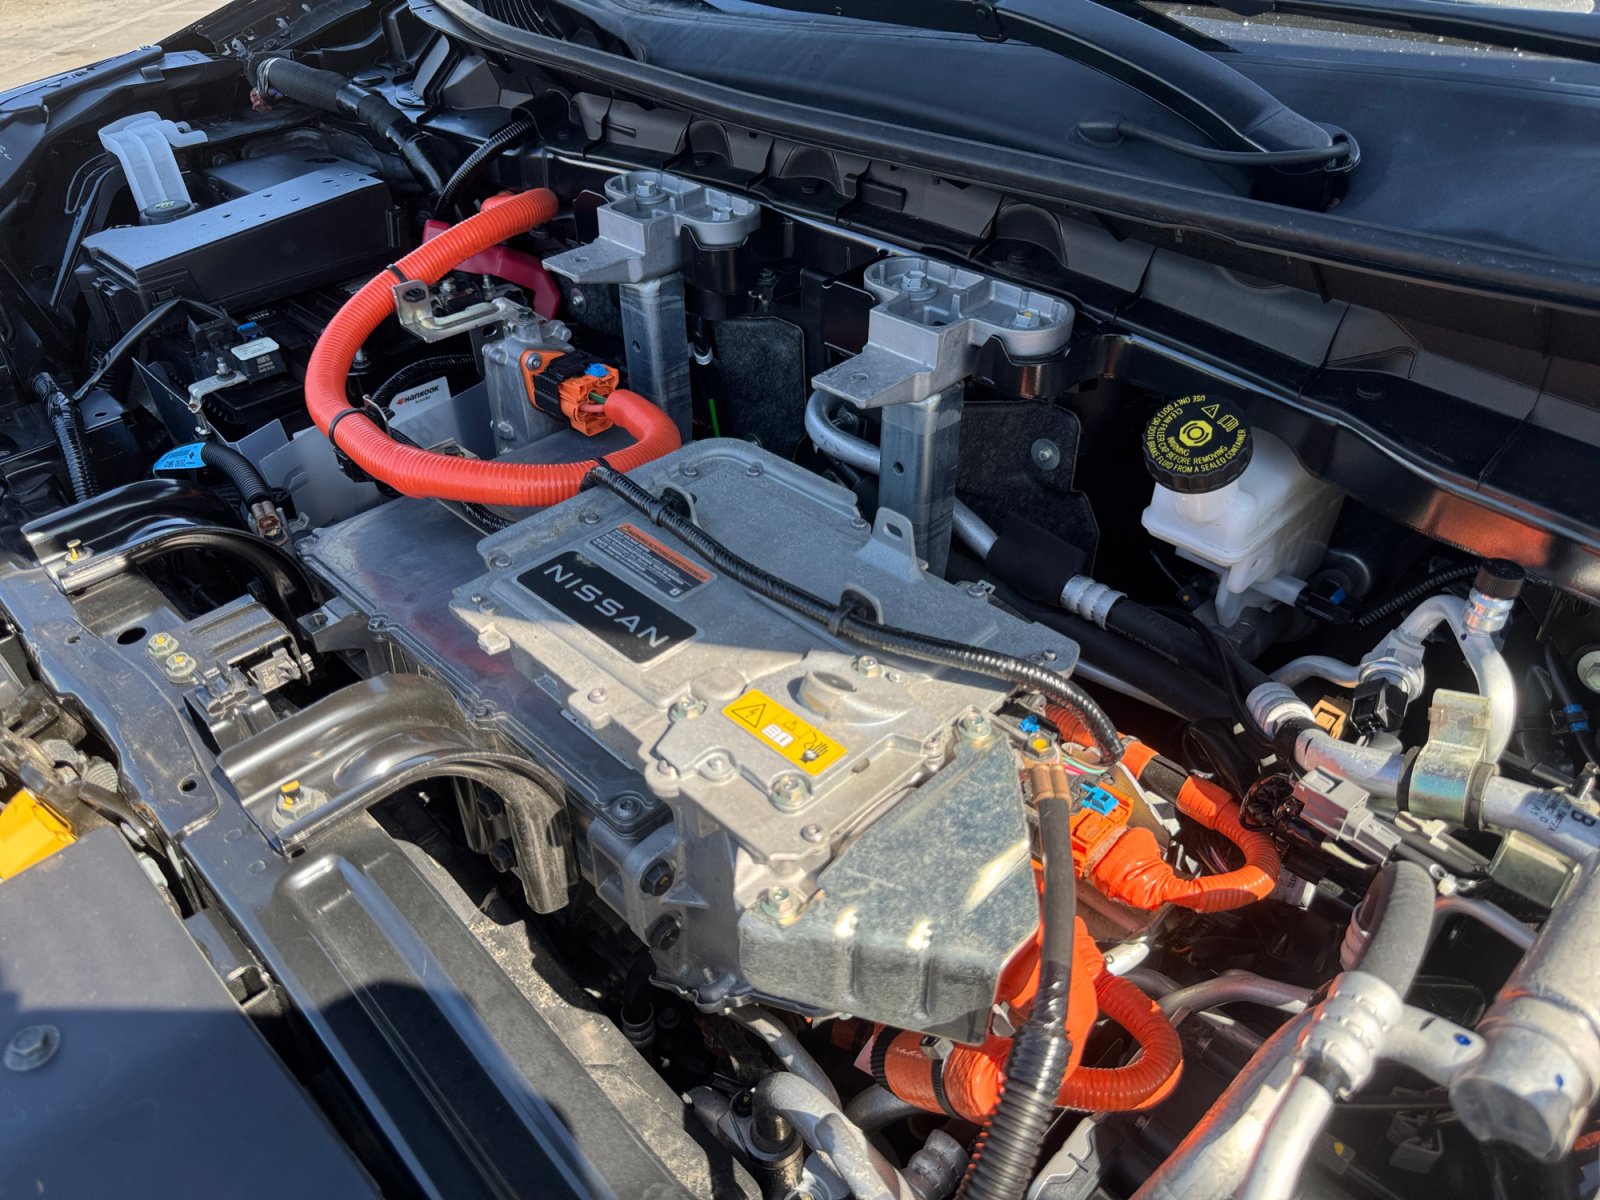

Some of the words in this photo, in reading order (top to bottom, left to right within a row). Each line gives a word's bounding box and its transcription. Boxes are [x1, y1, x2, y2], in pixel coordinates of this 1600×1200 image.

[1173, 396, 1191, 408] ONLY
[1151, 417, 1161, 426] OR
[1164, 408, 1183, 424] CLEAN
[1158, 442, 1170, 453] CAP
[1167, 436, 1190, 456] WARNING
[1225, 429, 1246, 460] CONTAINER
[1166, 451, 1191, 465] BEFORE
[1193, 445, 1227, 464] REMOVING
[1156, 455, 1174, 470] FLUID
[1173, 464, 1193, 473] FROM
[1194, 465, 1200, 473] A
[1201, 457, 1226, 471] SEALED
[543, 563, 670, 649] NISSAN
[1571, 810, 1596, 826] B
